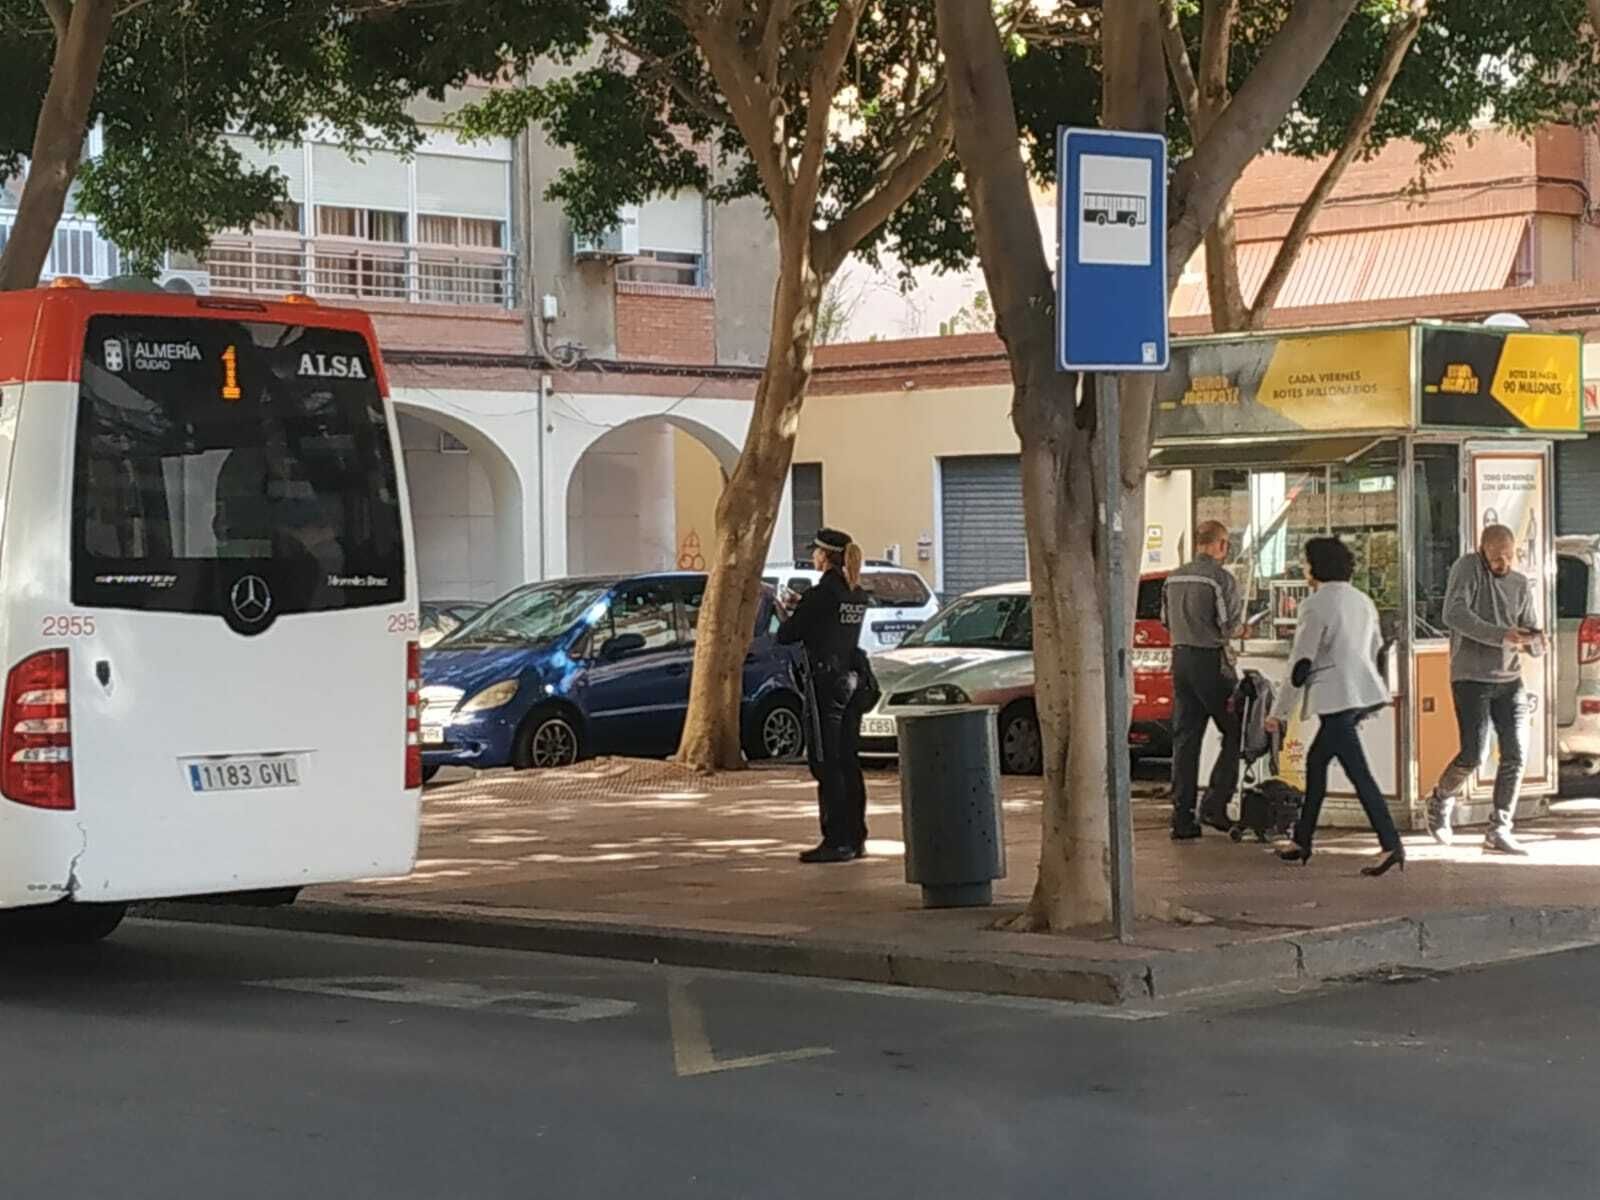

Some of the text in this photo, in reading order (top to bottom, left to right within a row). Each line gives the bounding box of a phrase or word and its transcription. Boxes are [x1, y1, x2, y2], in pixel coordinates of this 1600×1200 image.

[134, 341, 202, 361] ALMERÍA
[135, 360, 172, 371] CIUDAD
[221, 345, 241, 399] 1
[298, 354, 367, 379] ALSA
[1287, 370, 1362, 385] CADA VIERNES
[1273, 388, 1303, 400] BOTES
[1503, 381, 1562, 396] 90 MILLONES
[42, 616, 96, 636] 2955
[203, 761, 297, 788] 1183 GVL
